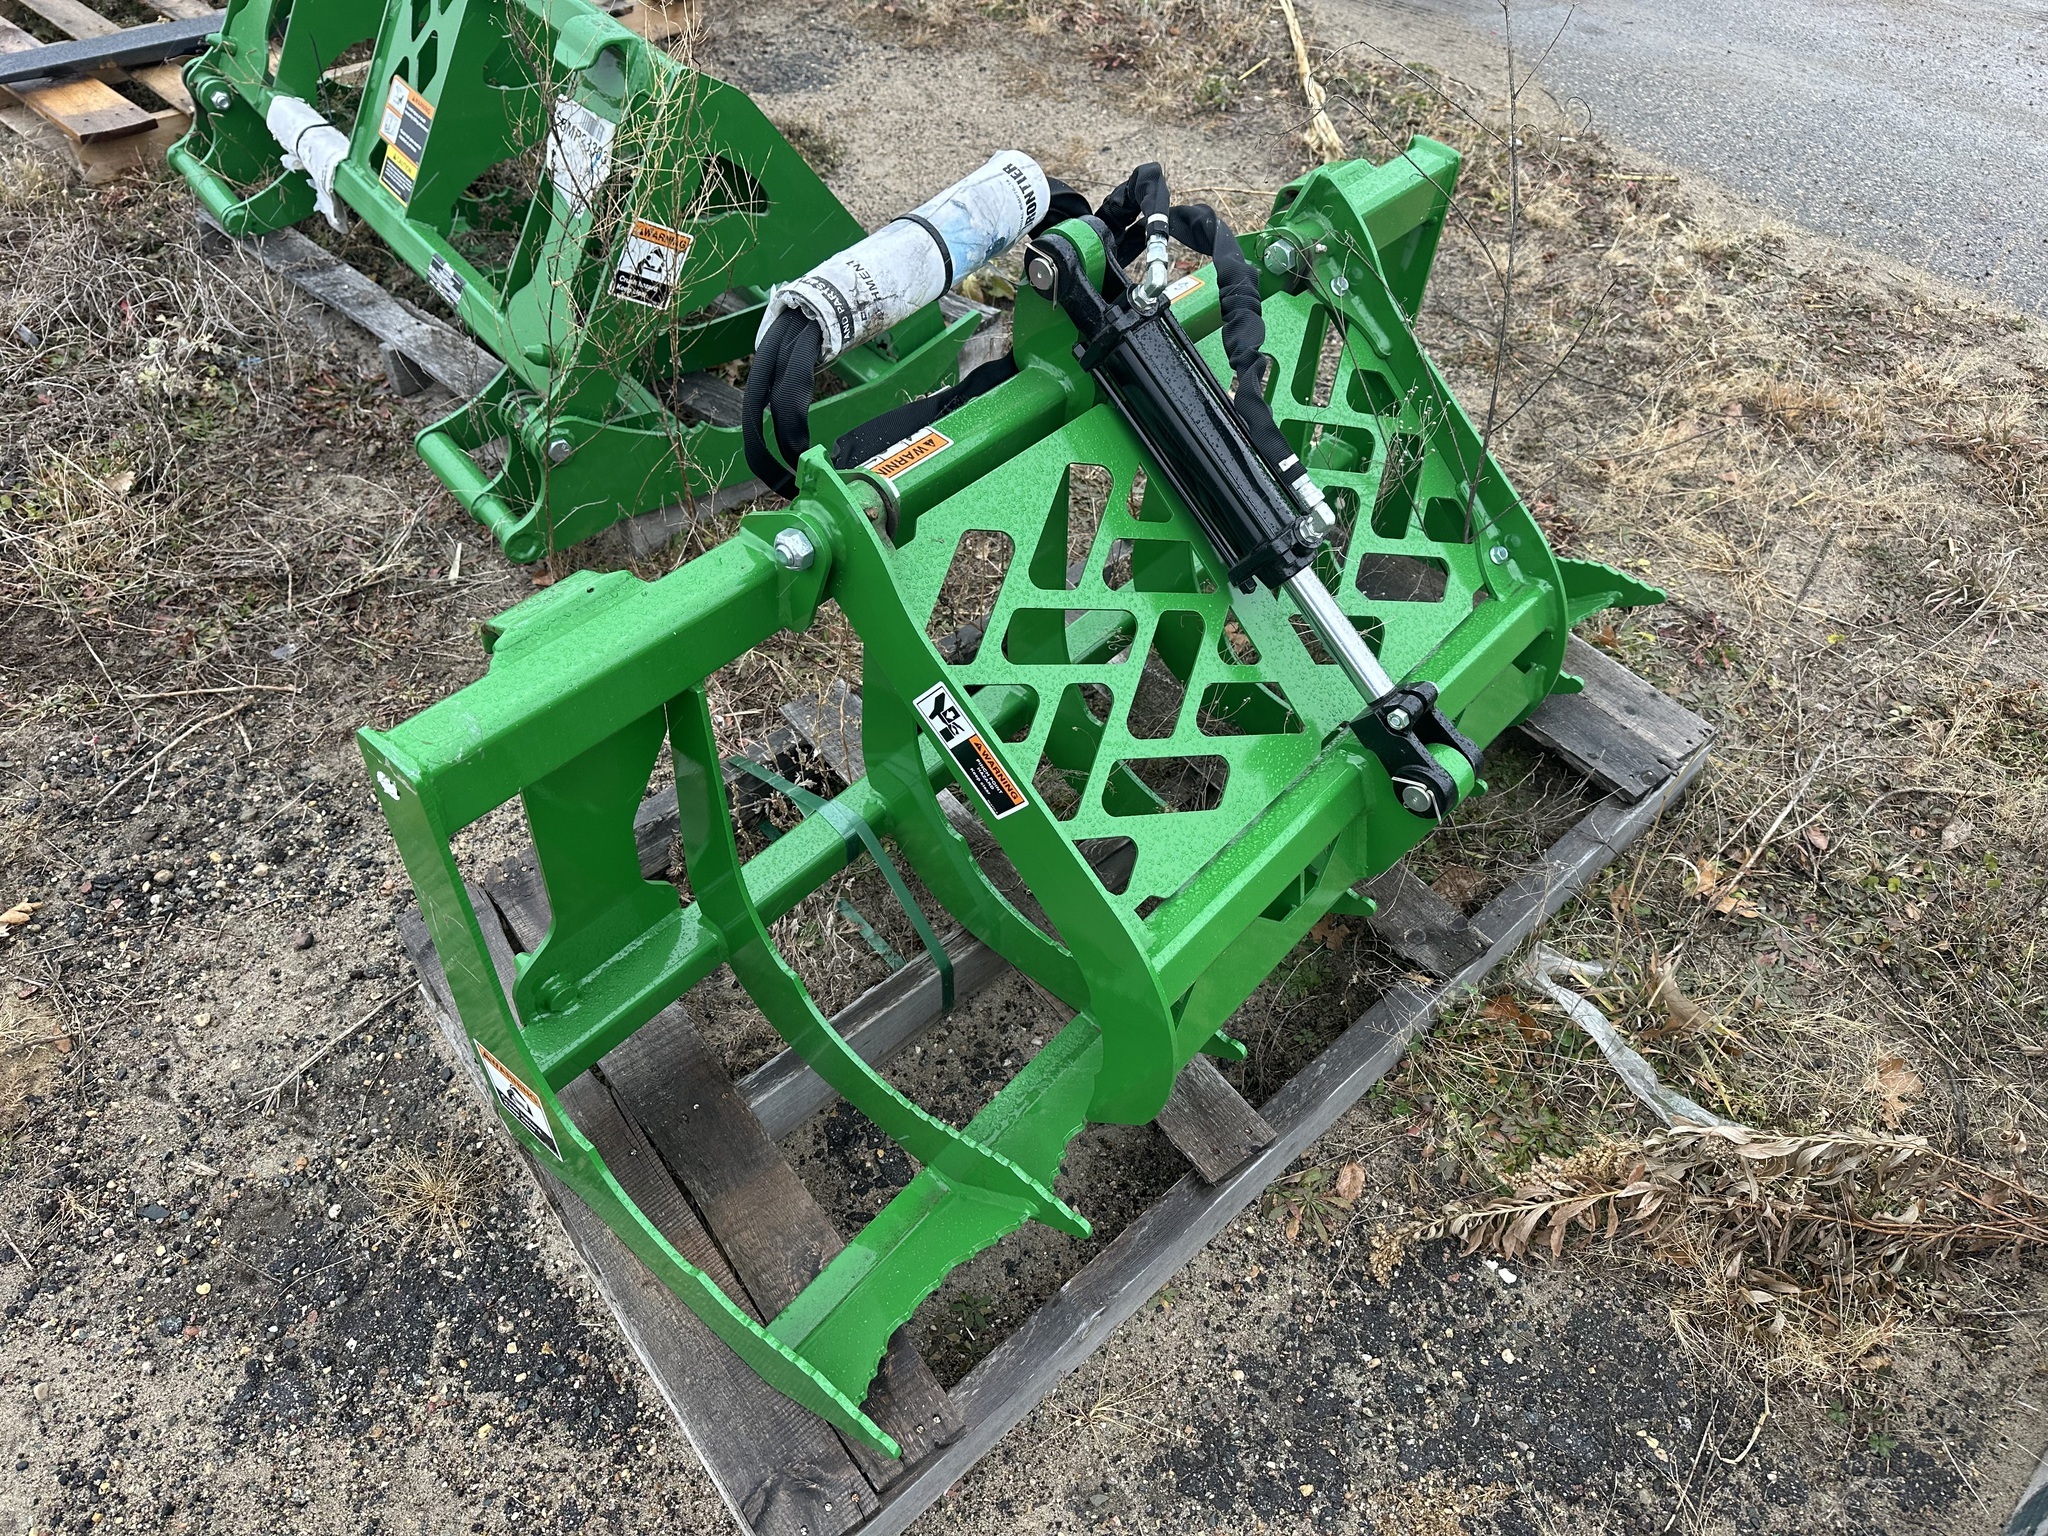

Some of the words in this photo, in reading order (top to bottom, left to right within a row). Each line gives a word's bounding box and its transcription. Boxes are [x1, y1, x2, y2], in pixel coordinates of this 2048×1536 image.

[816, 282, 845, 314] PARTS
[841, 315, 851, 339] AND
[877, 446, 929, 475] WARNIN
[969, 766, 981, 782] Keep
[975, 758, 990, 777] PINCH
[988, 776, 1003, 794] POINT
[976, 766, 995, 790] HAZARD
[982, 750, 1018, 800] WARNING
